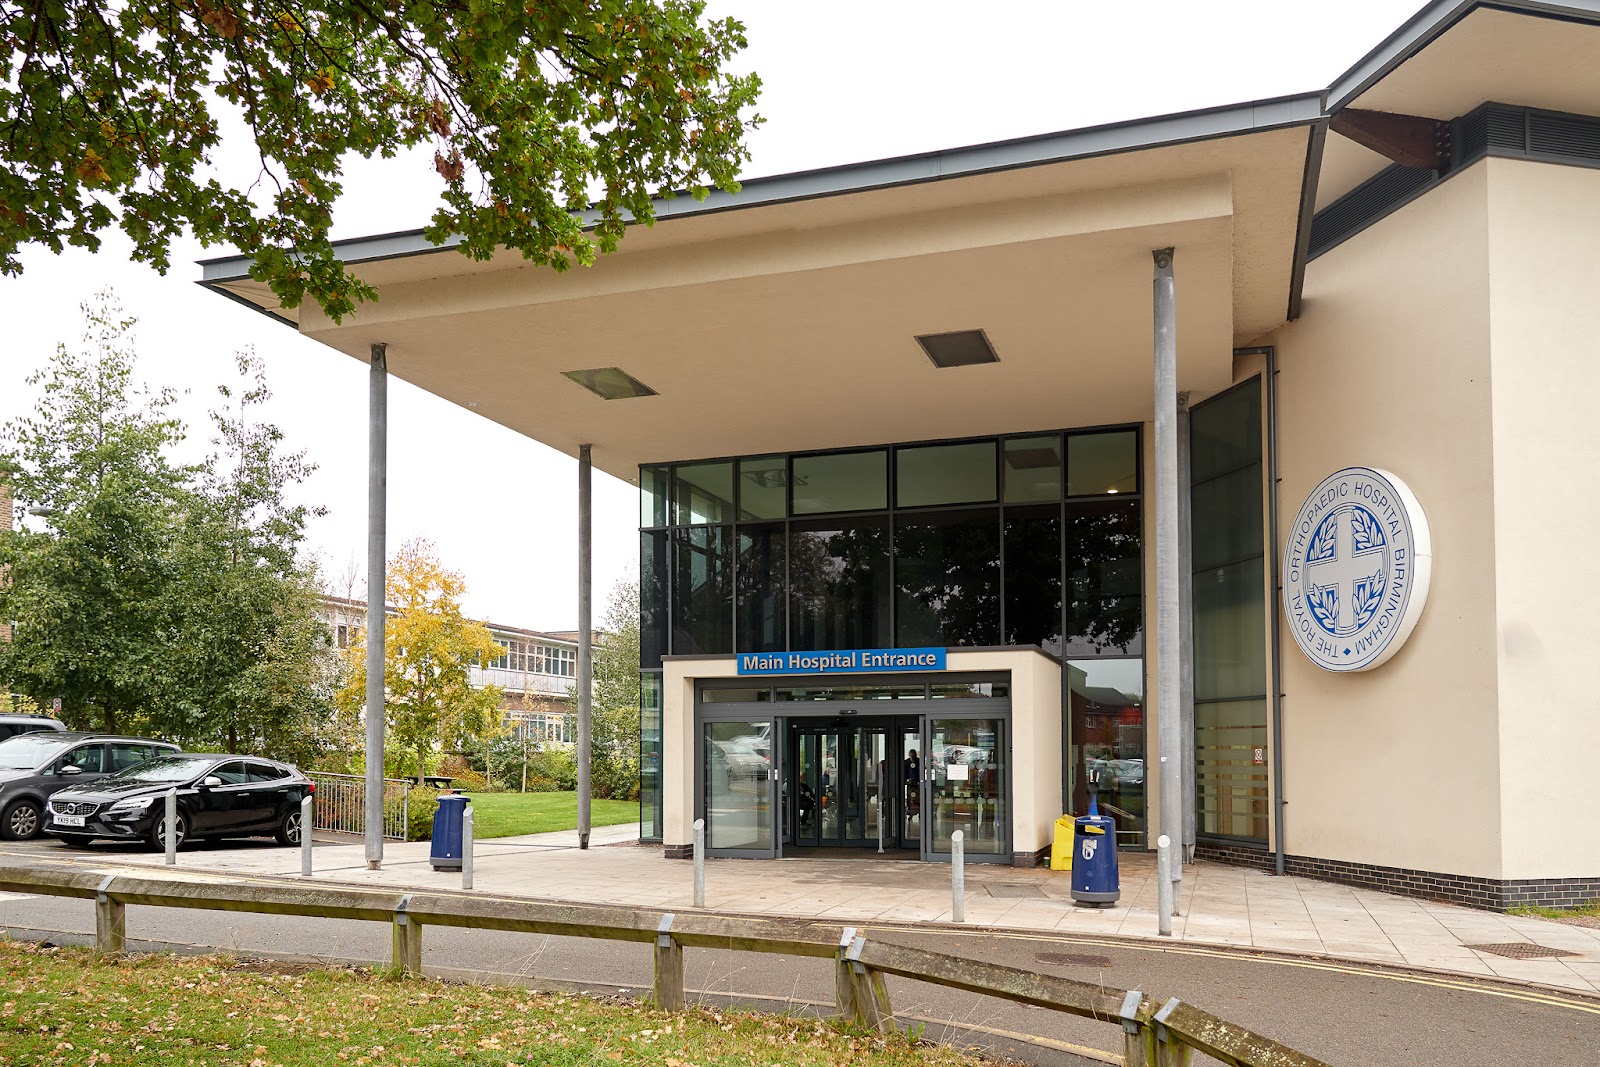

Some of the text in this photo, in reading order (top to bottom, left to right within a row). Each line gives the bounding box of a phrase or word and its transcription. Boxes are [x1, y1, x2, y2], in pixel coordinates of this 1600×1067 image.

[1291, 481, 1405, 658] THE ROYAL ORTHOPAEDIC HOSPITAL BIRMINGHAM
[743, 652, 937, 672] Main Hospital Entrance
